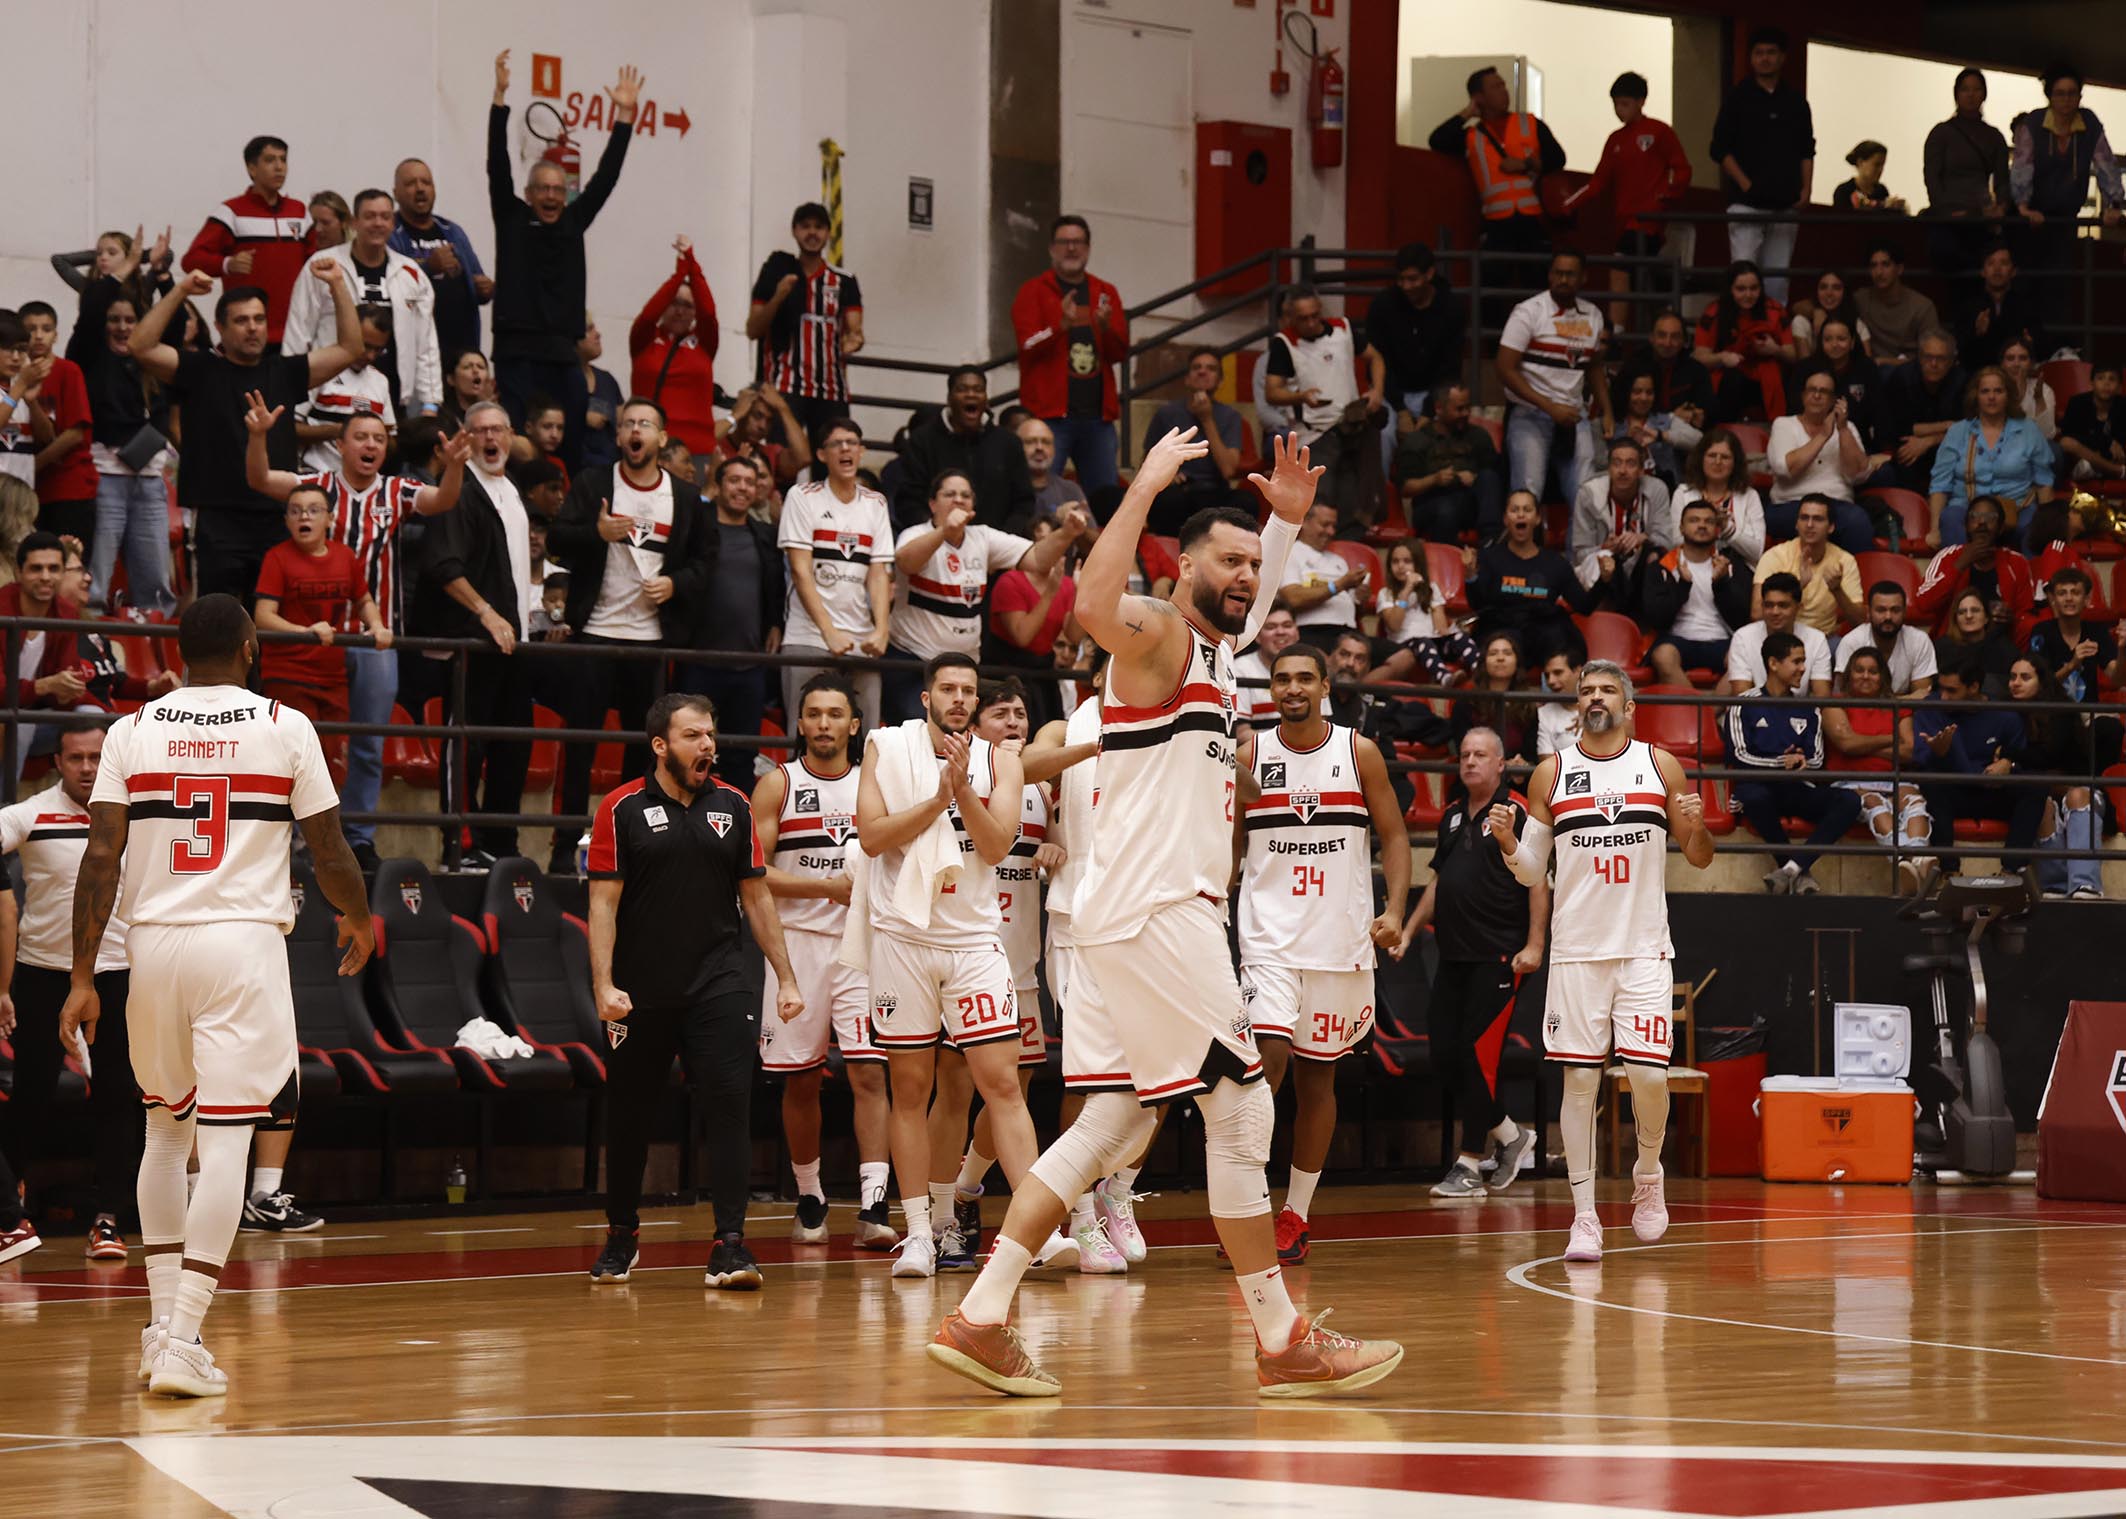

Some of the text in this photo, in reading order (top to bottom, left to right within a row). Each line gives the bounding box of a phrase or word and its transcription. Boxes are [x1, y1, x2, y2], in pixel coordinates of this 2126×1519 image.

[153, 707, 257, 726] SUPERBET
[168, 740, 239, 758] BENNETT
[1291, 795, 1319, 804] SPFC
[1597, 796, 1624, 806] SPFC
[170, 775, 230, 876] 3
[709, 813, 732, 824] SPFC
[824, 817, 851, 827] SPFC
[1268, 838, 1346, 855] SUPERBET
[1571, 829, 1651, 848] SUPERBET
[1593, 855, 1630, 884] 40
[1292, 866, 1324, 896] 34
[876, 1000, 896, 1008] SPFC
[958, 993, 997, 1028] 20
[1312, 1013, 1345, 1042] 34
[1634, 1015, 1667, 1044] 40
